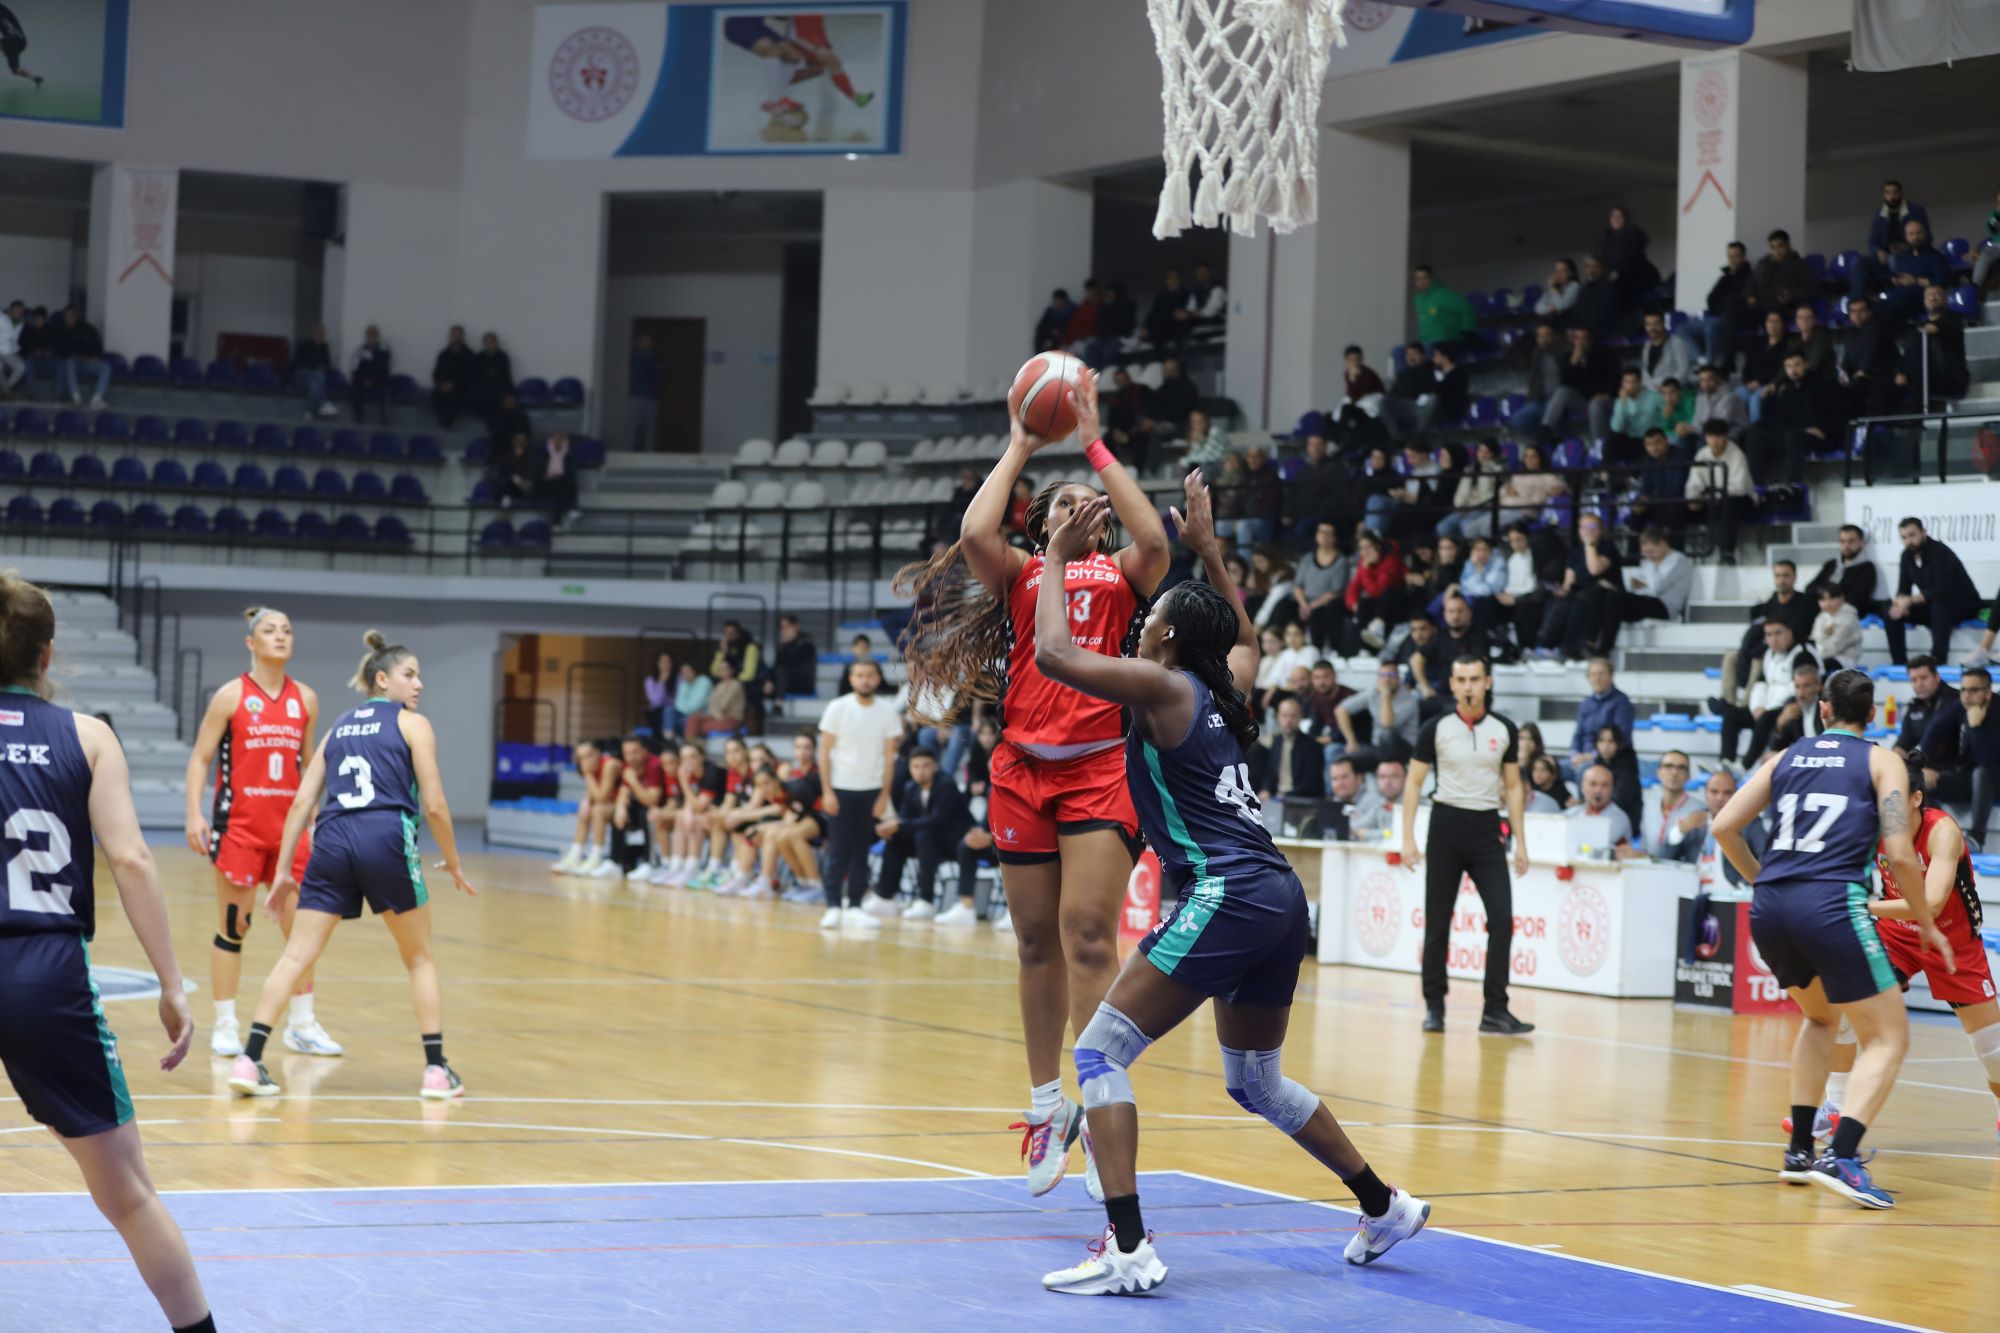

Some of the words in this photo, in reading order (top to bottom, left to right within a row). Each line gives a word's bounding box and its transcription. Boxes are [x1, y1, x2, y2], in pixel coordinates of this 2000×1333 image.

[336, 722, 381, 739] CEREN
[268, 752, 284, 782] 0
[337, 755, 375, 809] 3
[1771, 792, 1849, 853] 17
[4, 808, 76, 915] 2
[1511, 914, 1546, 939] POR
